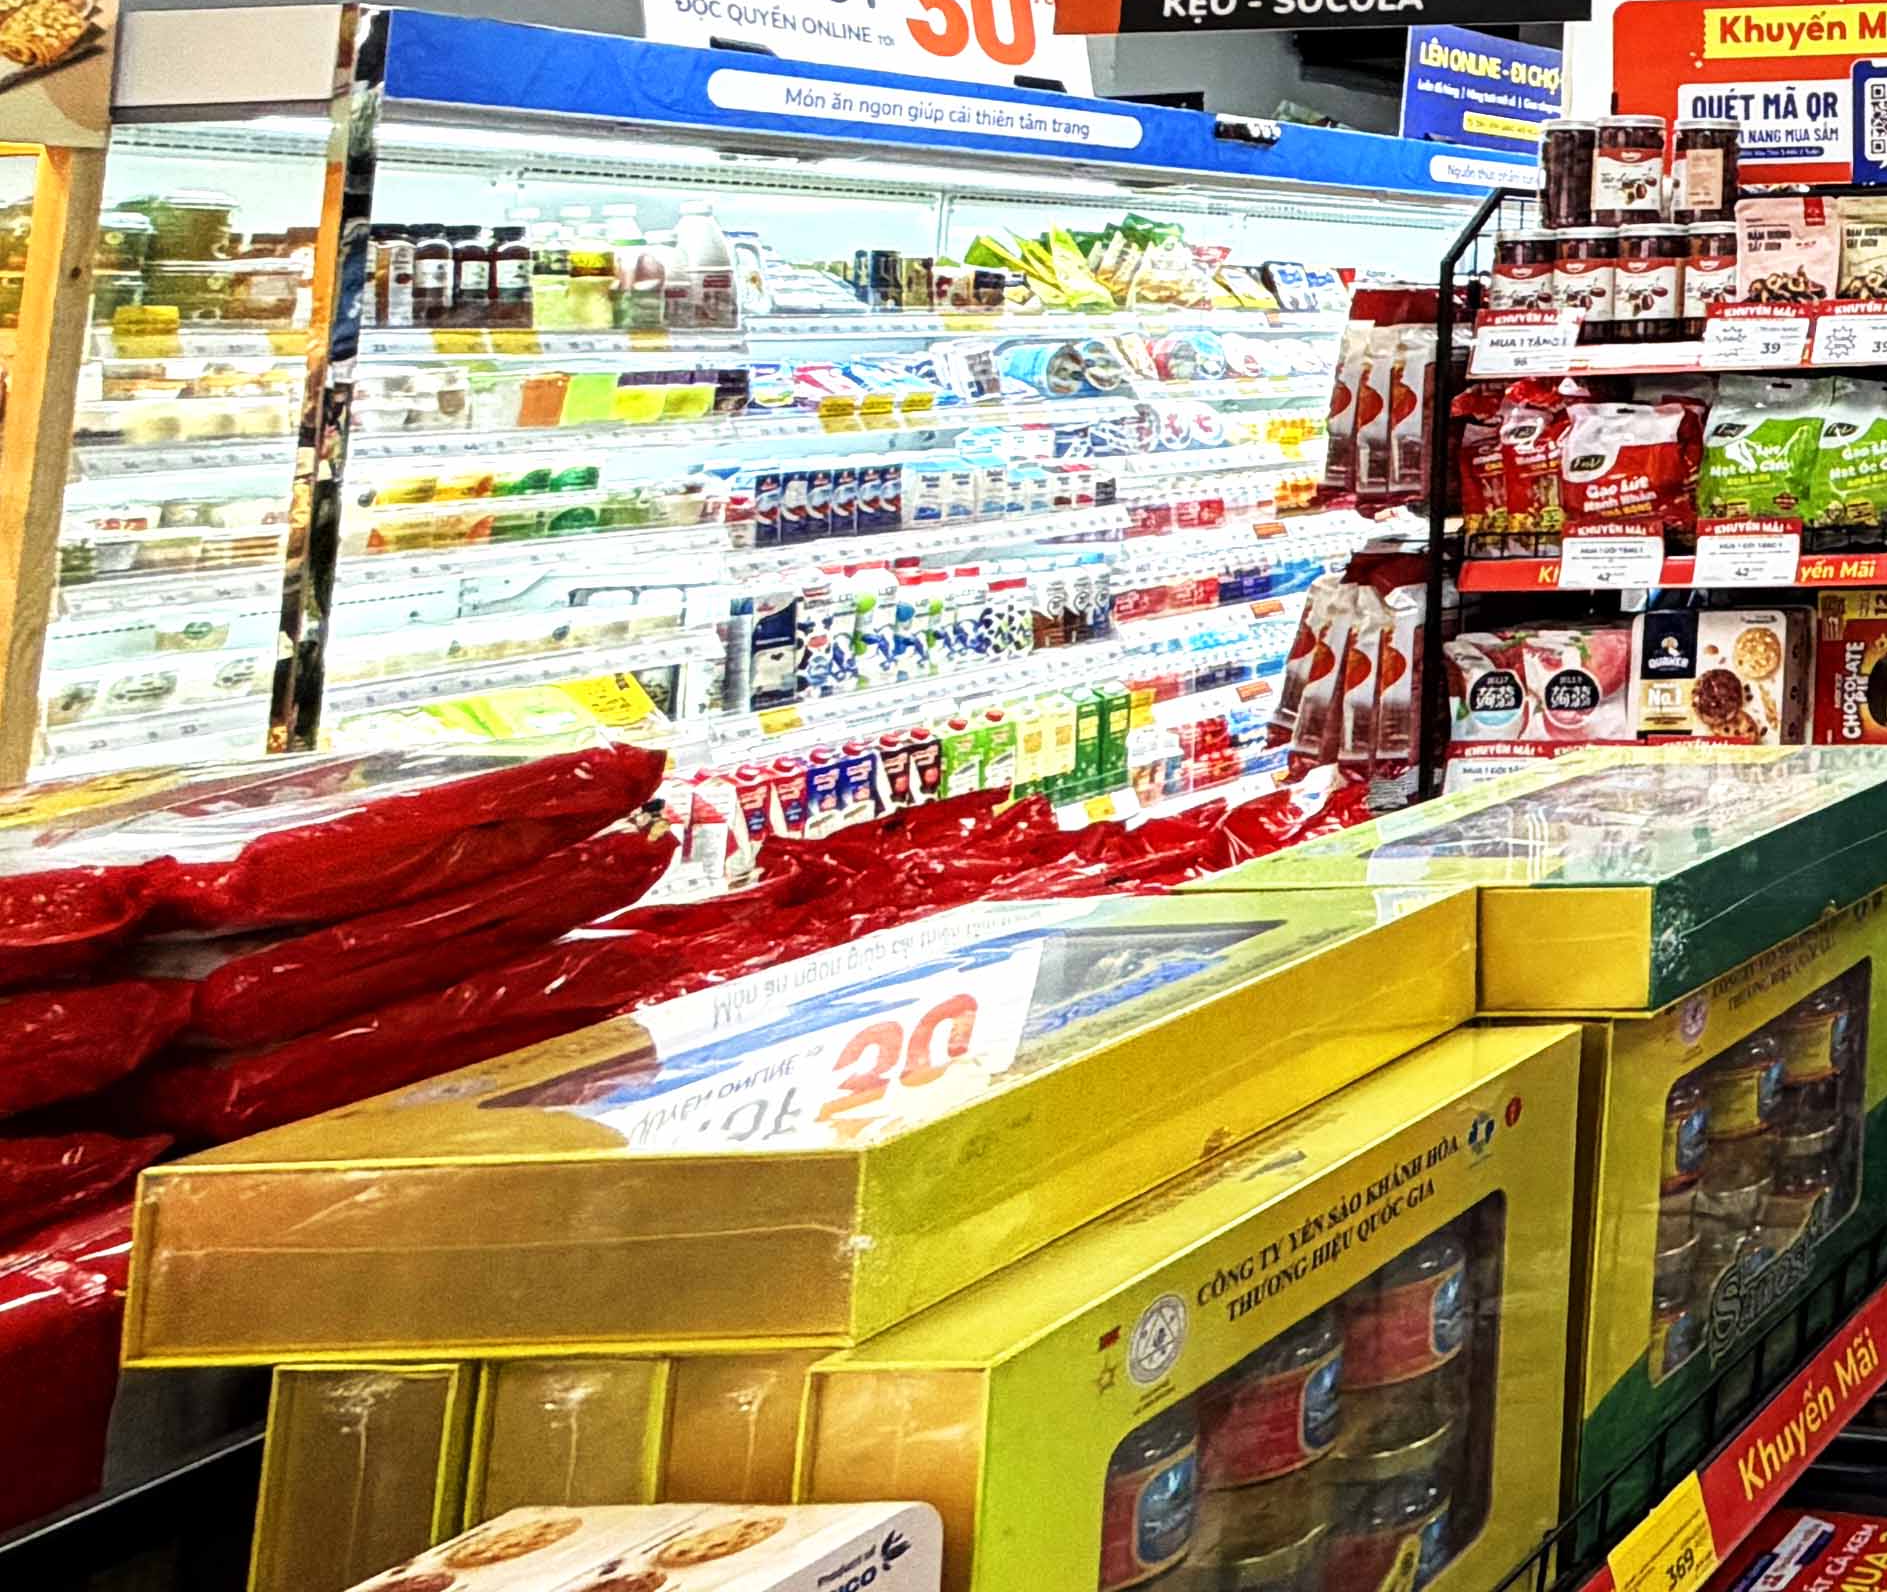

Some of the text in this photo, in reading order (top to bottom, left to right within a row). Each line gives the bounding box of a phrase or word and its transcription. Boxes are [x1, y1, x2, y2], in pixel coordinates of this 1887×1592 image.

[802, 18, 873, 45] ONLINE
[1718, 11, 1853, 54] Khuyến
[784, 87, 826, 109] Món
[831, 91, 855, 112] ăn
[859, 97, 903, 121] ngon
[908, 100, 945, 125] giúp
[1691, 86, 1839, 122] QUÉT MÃ QR
[1785, 127, 1811, 143] MUA
[1760, 342, 1781, 355] 39
[1838, 558, 1875, 581] Mãi
[1842, 641, 1865, 739] CHOCOLATE
[1857, 675, 1868, 704] PIE
[1196, 1135, 1460, 1308] CÔNG TY YẾN SÀO KHÁNH HÒA
[1225, 1177, 1436, 1323] THƯƠNG HIỆU QUỐC GIA
[1737, 1327, 1880, 1502] Khuyến Mãi
[1664, 1547, 1696, 1592] 369
